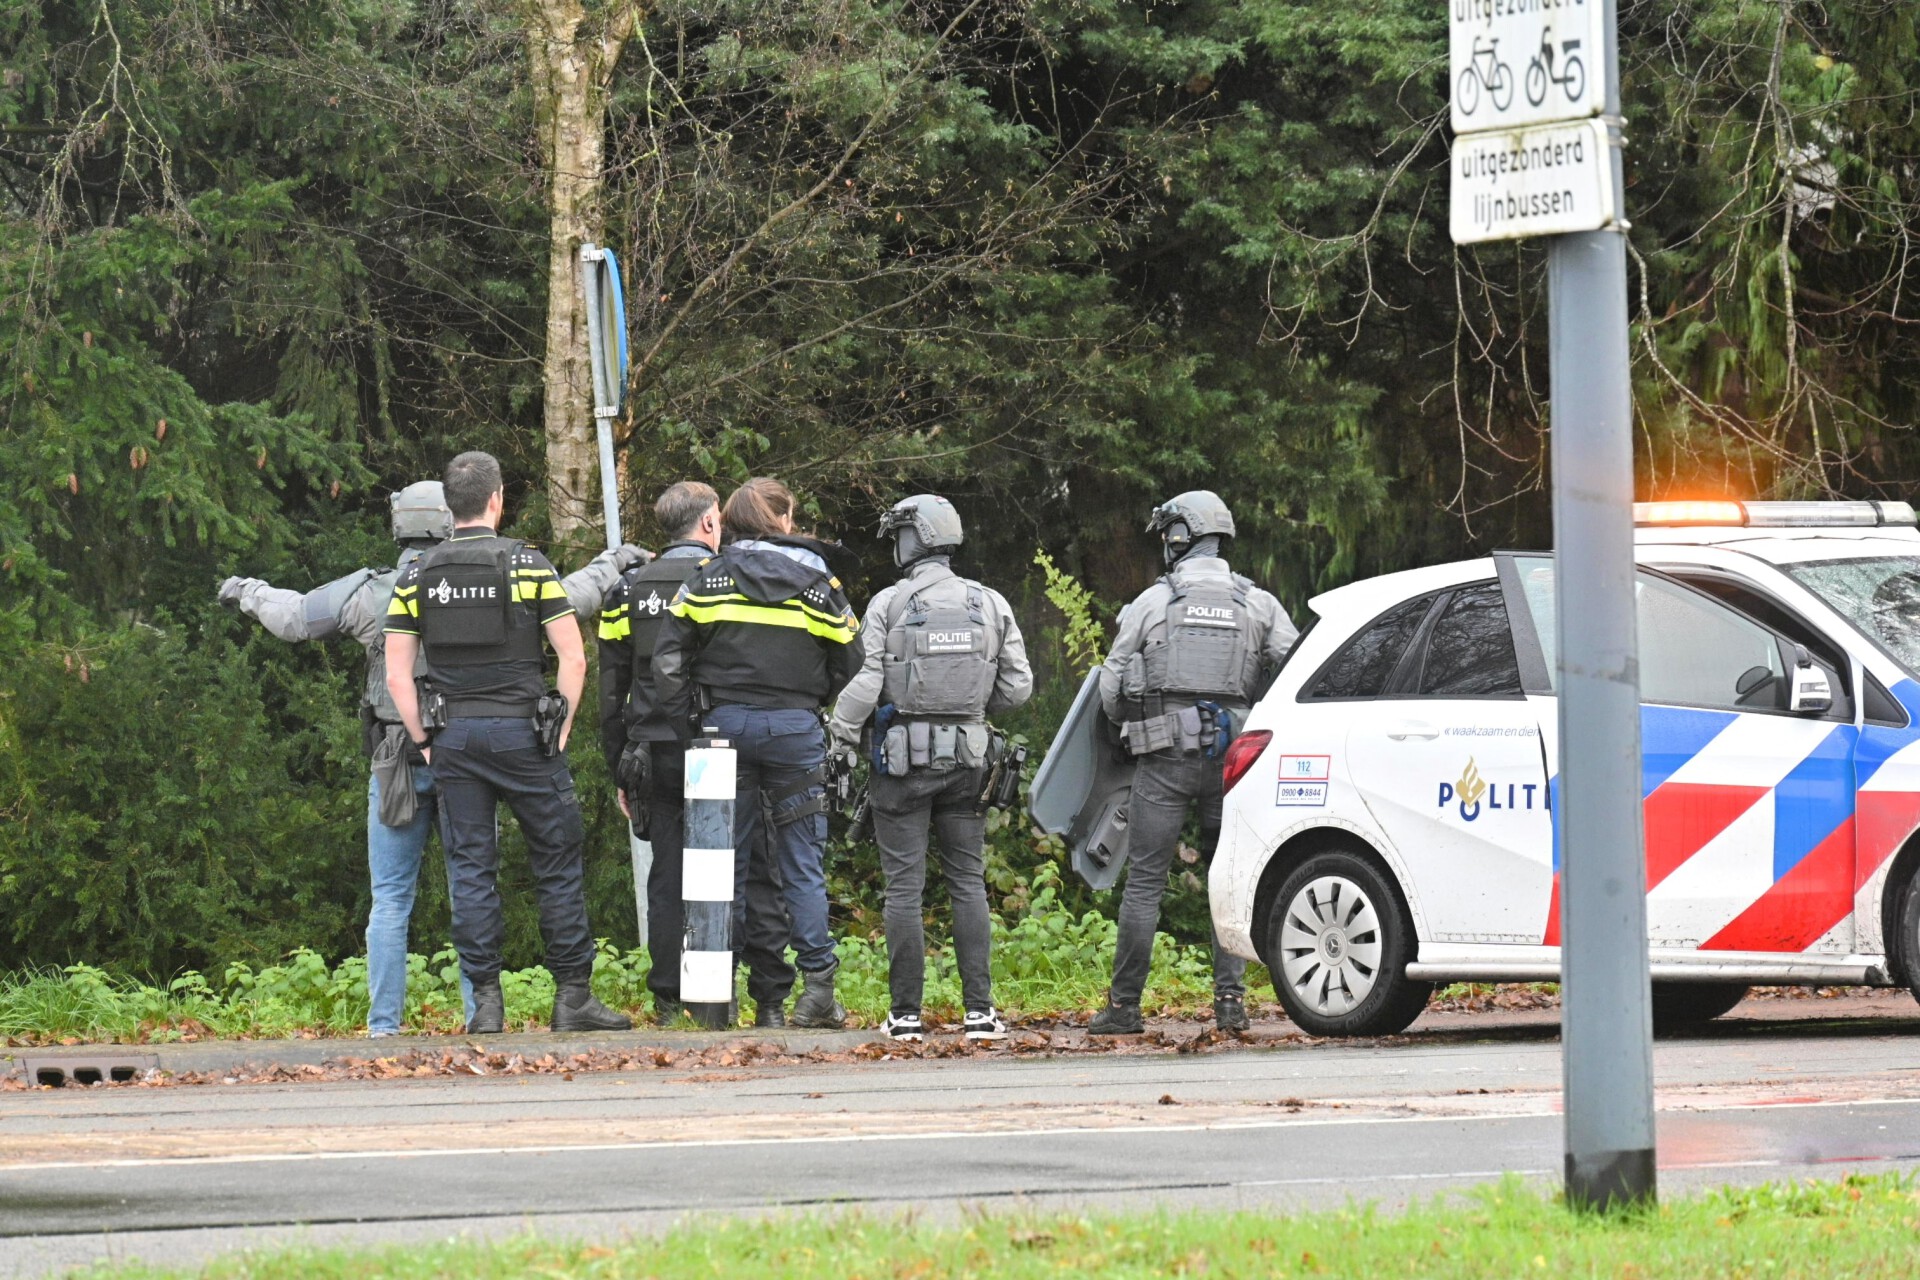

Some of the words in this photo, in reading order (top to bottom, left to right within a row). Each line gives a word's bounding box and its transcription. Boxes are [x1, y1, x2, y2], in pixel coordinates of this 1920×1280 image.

[1456, 0, 1583, 27] uitgezon
[1462, 132, 1584, 184] uitgezonderd
[1474, 190, 1574, 232] lijnbussen
[428, 586, 496, 604] POLITIE
[1187, 606, 1234, 619] POLITIE
[929, 632, 972, 643] POLITIE
[1452, 724, 1503, 737] waakzaam
[1504, 727, 1517, 737] en
[1297, 760, 1311, 772] 112
